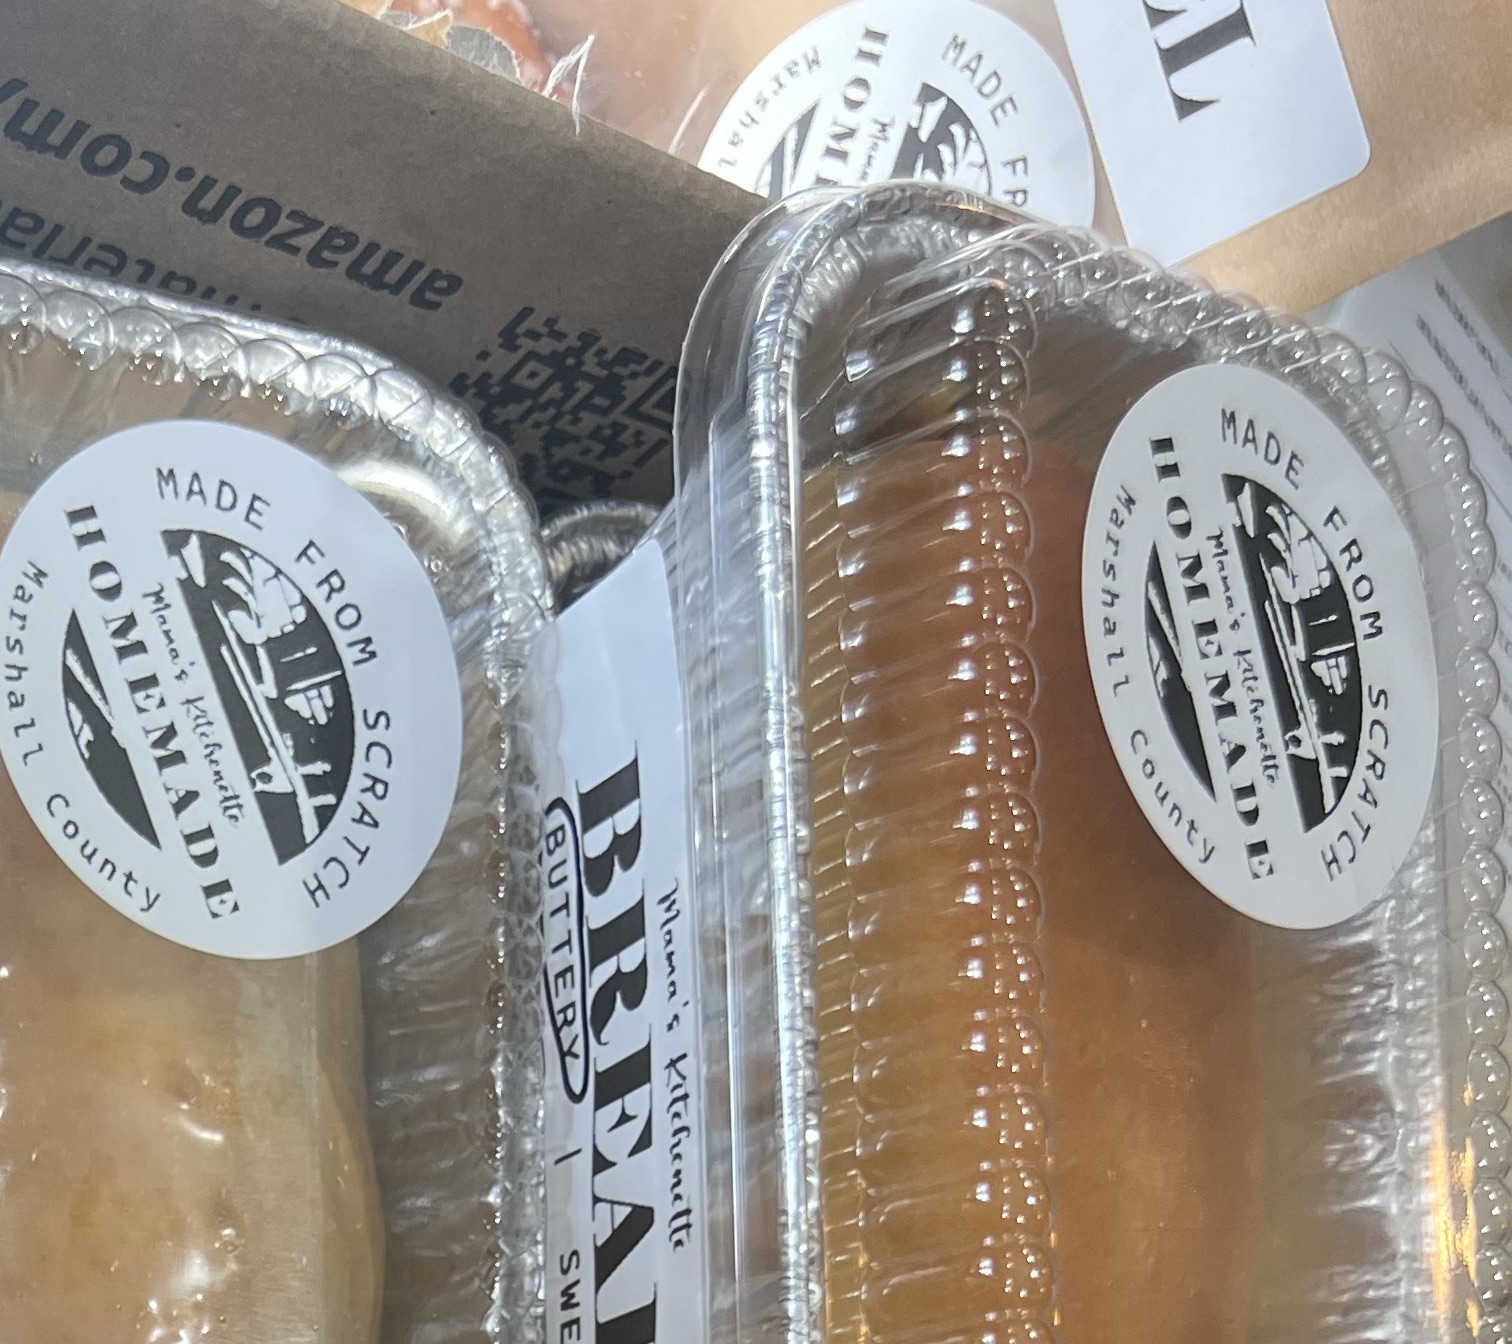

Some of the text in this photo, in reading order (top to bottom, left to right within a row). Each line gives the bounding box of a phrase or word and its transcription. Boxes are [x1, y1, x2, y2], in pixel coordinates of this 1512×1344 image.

[717, 45, 823, 169] Marshal
[941, 32, 1029, 208] MADE FR
[5, 560, 162, 914] Marshall County
[64, 504, 240, 919] HOMEMADE
[156, 467, 393, 908] MADE FROM SCRATCH
[1100, 485, 1217, 865] Marshall County
[1149, 437, 1274, 881] HOMEMADE
[1220, 408, 1389, 883] MADE FROM SCRATCH
[545, 824, 580, 1060] BUTTERY
[657, 878, 692, 1252] Mama's Kitchenette
